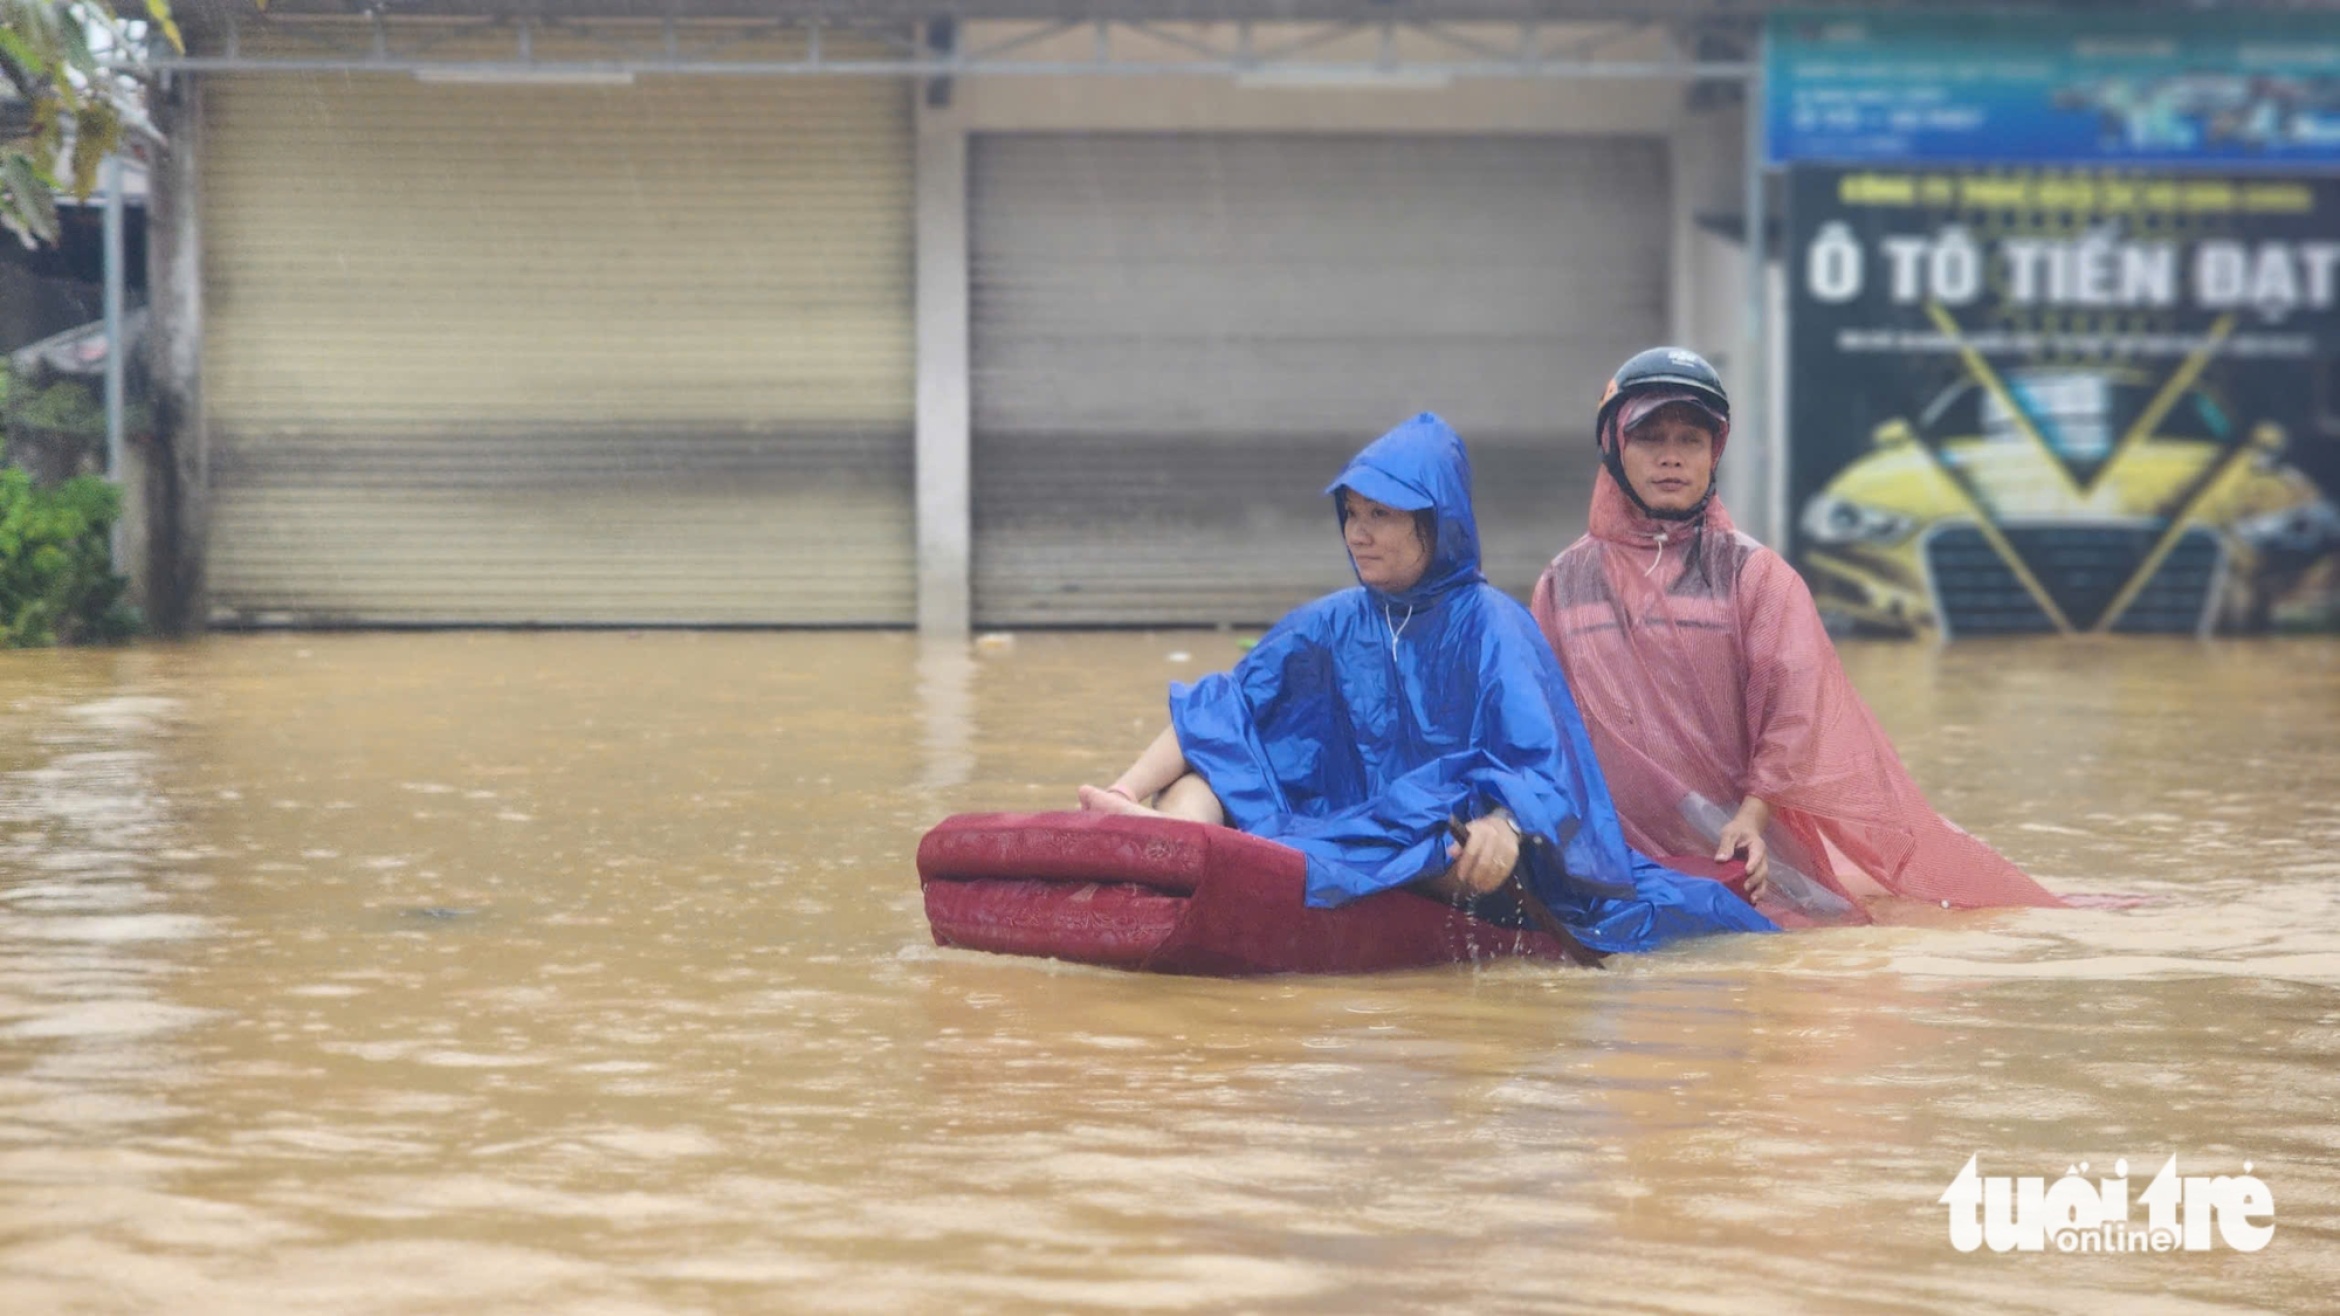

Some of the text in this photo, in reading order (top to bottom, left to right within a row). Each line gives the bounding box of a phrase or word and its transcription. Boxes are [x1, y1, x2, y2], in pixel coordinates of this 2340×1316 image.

[1808, 220, 1864, 301] Ô
[1882, 222, 1981, 303] TÔ
[2004, 216, 2174, 304] TIẾN
